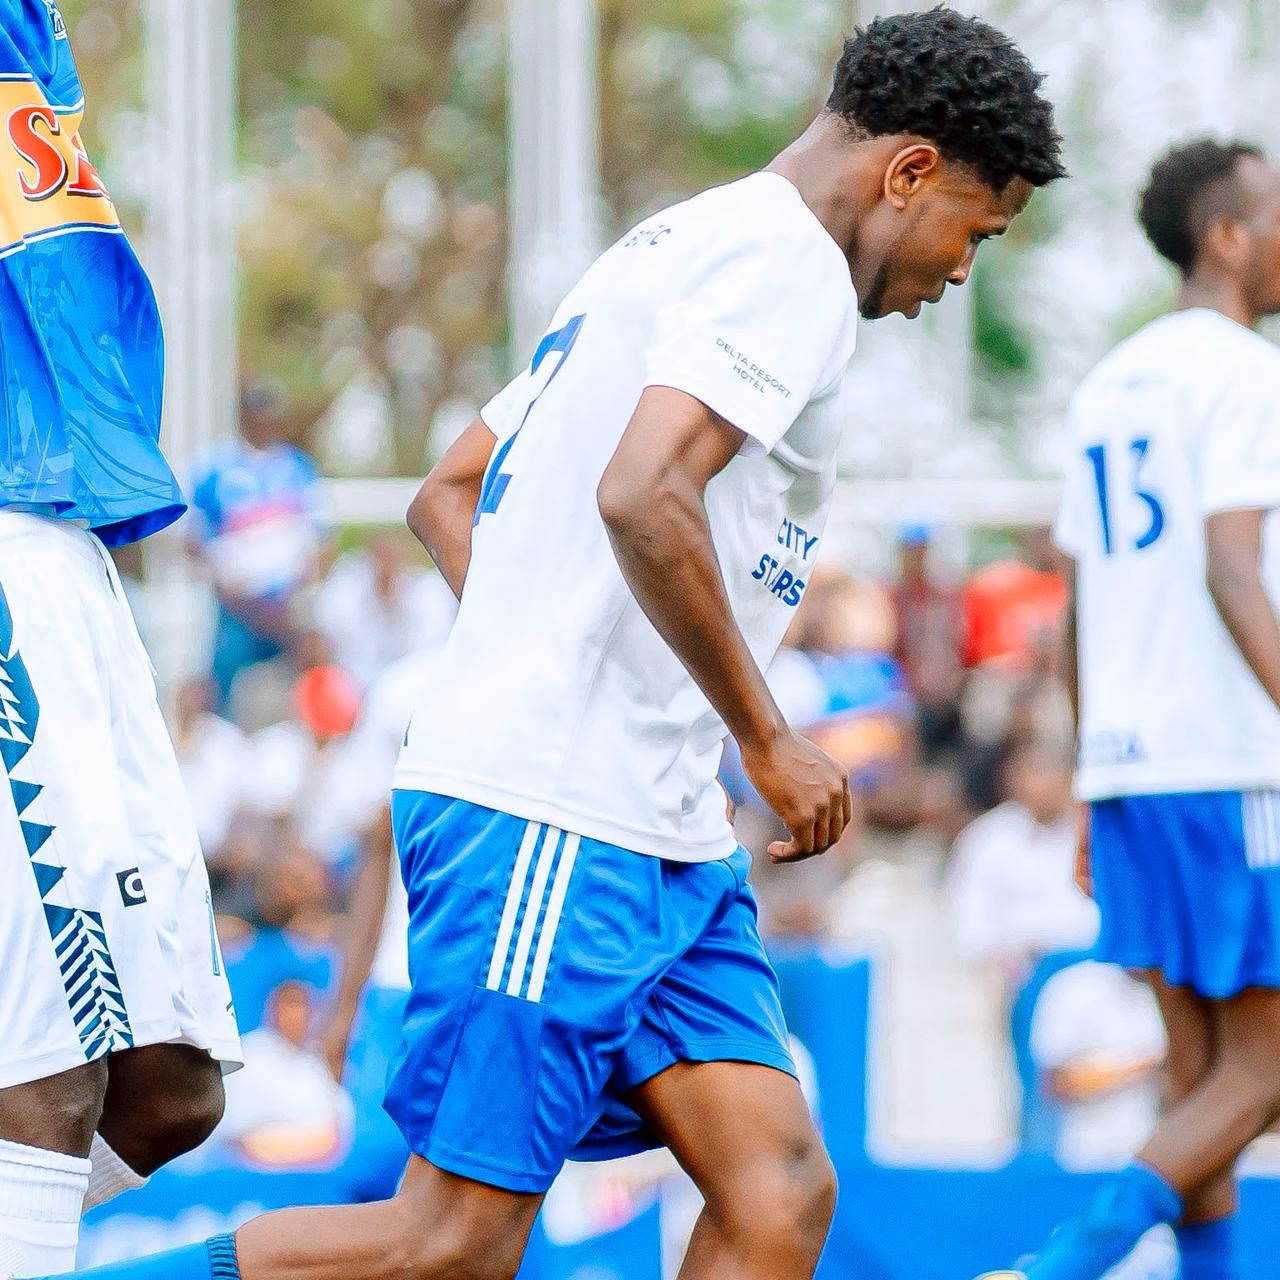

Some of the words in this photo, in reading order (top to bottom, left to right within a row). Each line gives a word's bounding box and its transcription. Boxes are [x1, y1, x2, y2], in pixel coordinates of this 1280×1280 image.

[716, 337, 749, 367] DELTA
[749, 362, 792, 399] RESORT
[732, 363, 765, 394] HOTEL
[1086, 438, 1165, 556] 13
[777, 516, 819, 561] CITY
